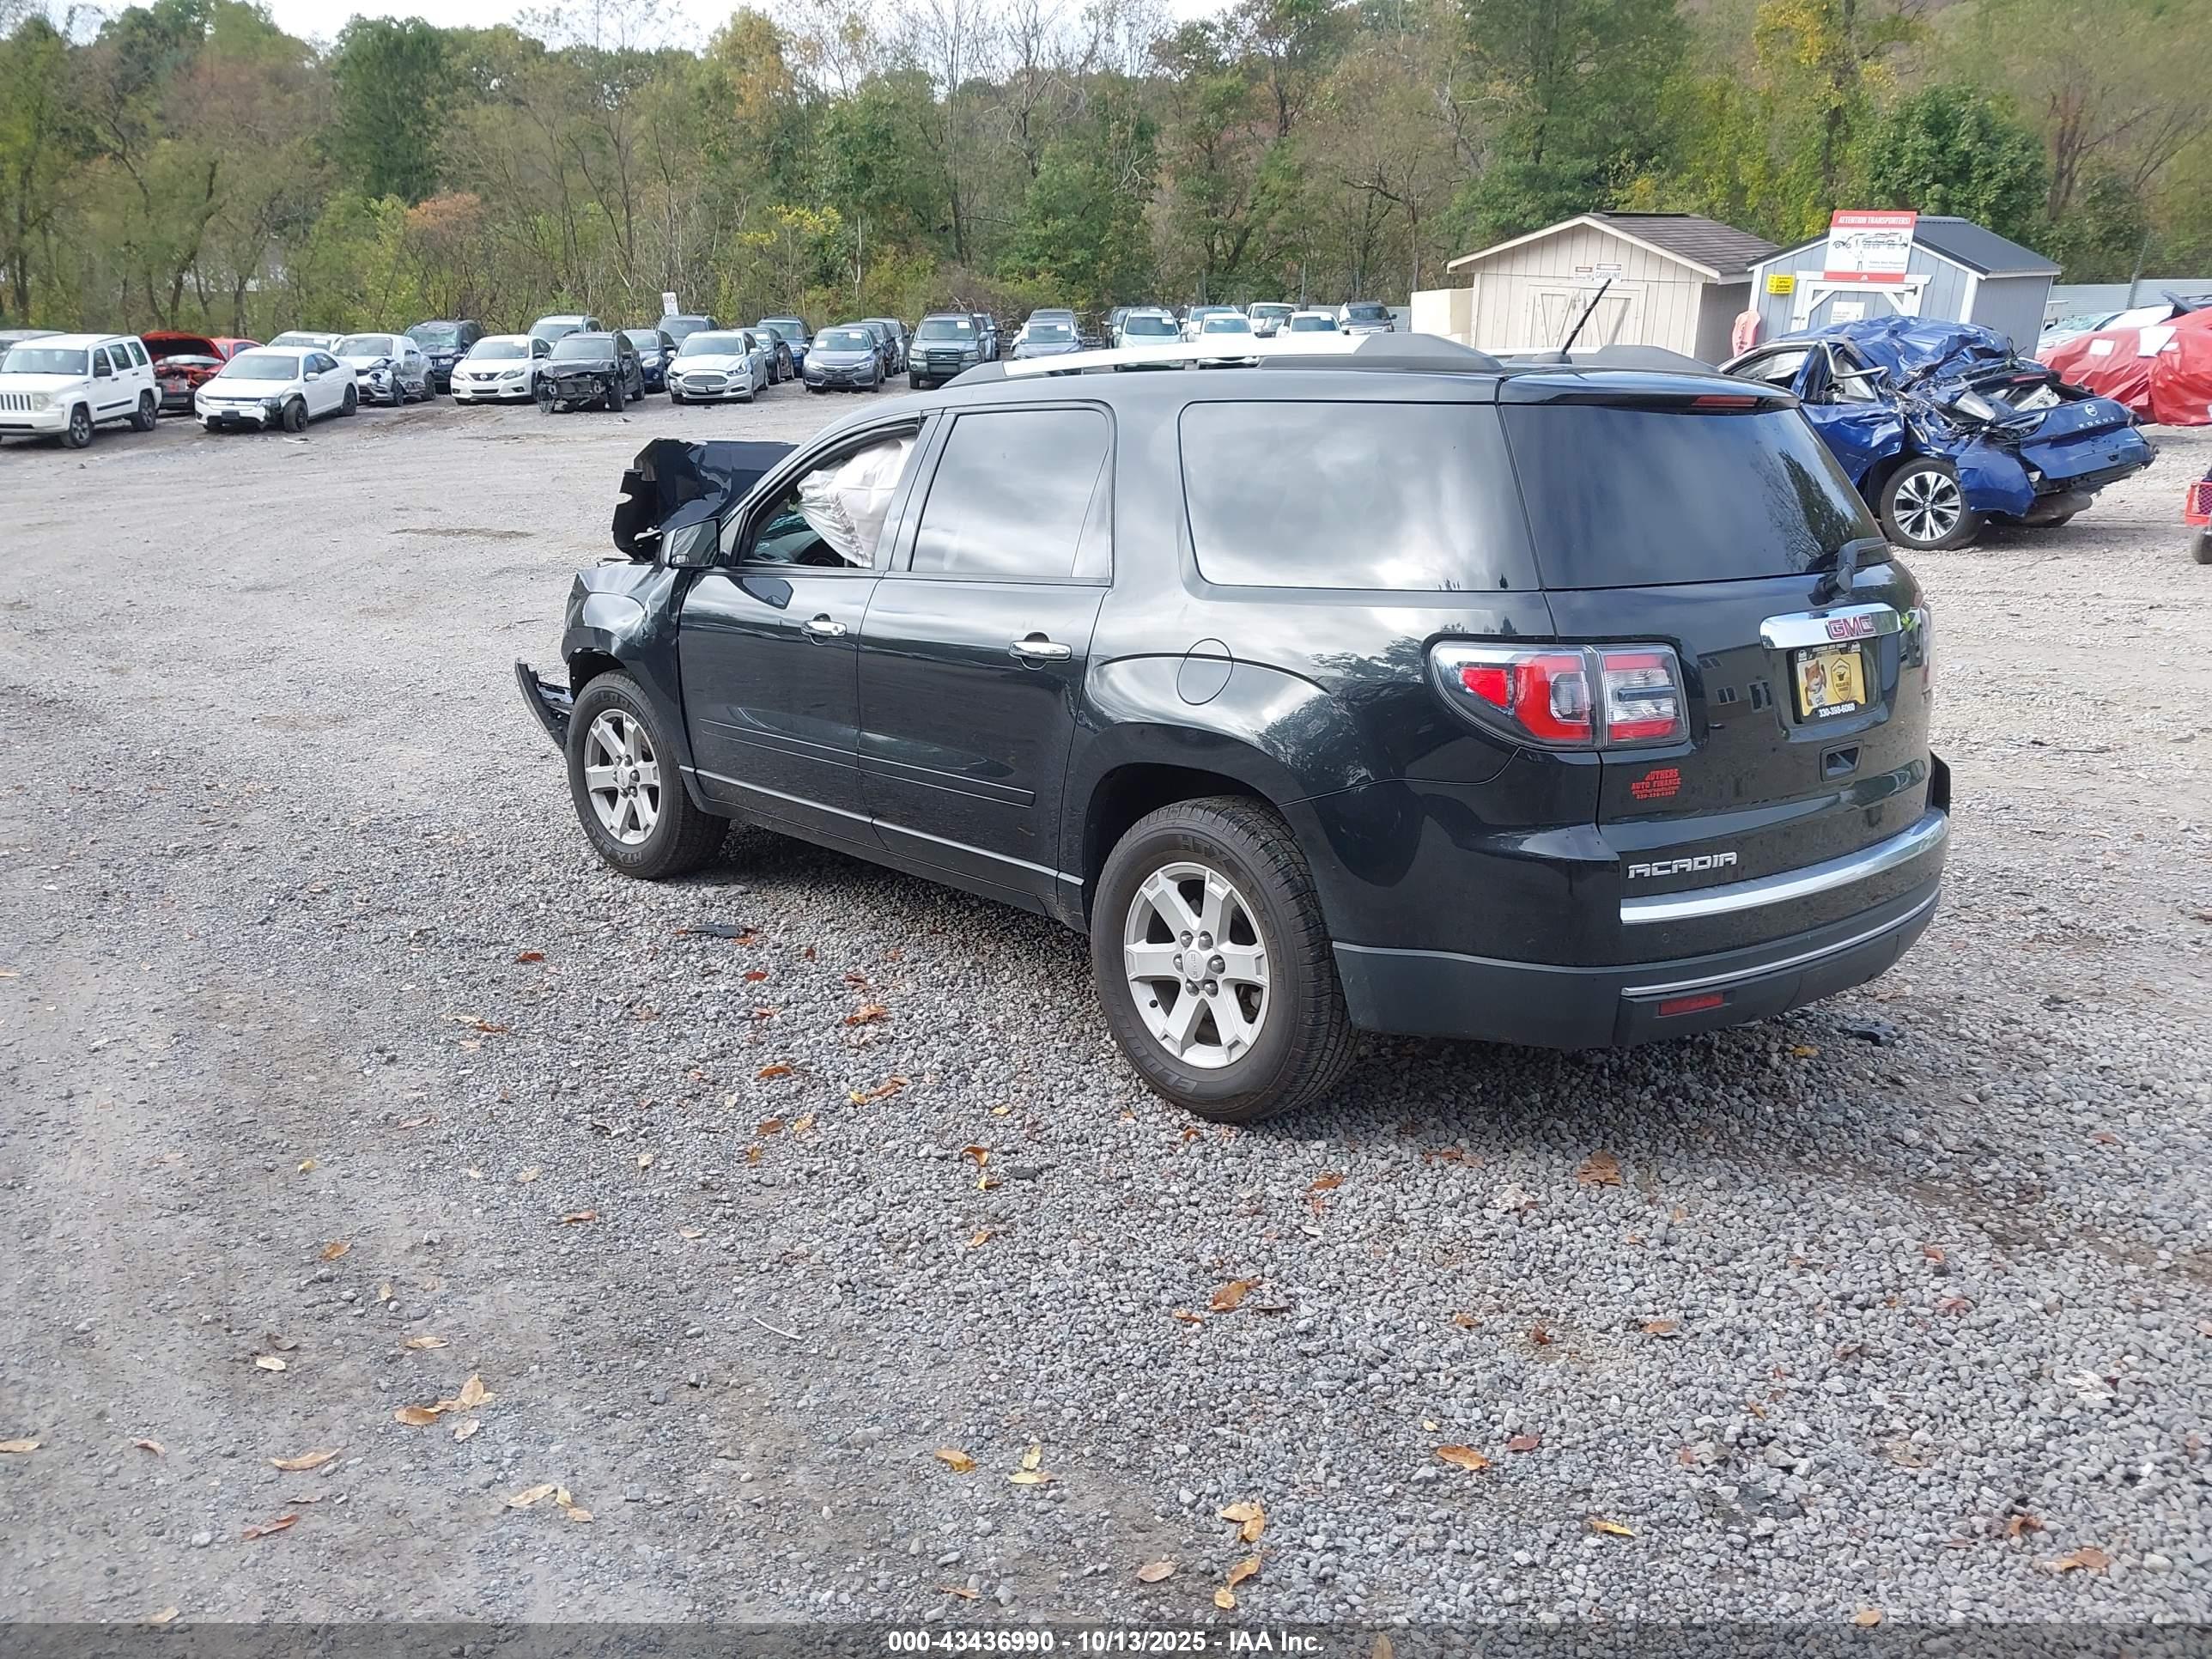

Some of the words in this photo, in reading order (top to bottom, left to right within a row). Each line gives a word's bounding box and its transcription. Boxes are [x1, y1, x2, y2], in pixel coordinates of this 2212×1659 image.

[2078, 416, 2116, 428] ROGUE
[1826, 613, 1876, 640] GMC
[1631, 781, 1650, 790] AUTO
[1653, 778, 1681, 787] FINANCE
[1627, 851, 1738, 879] ACADIA
